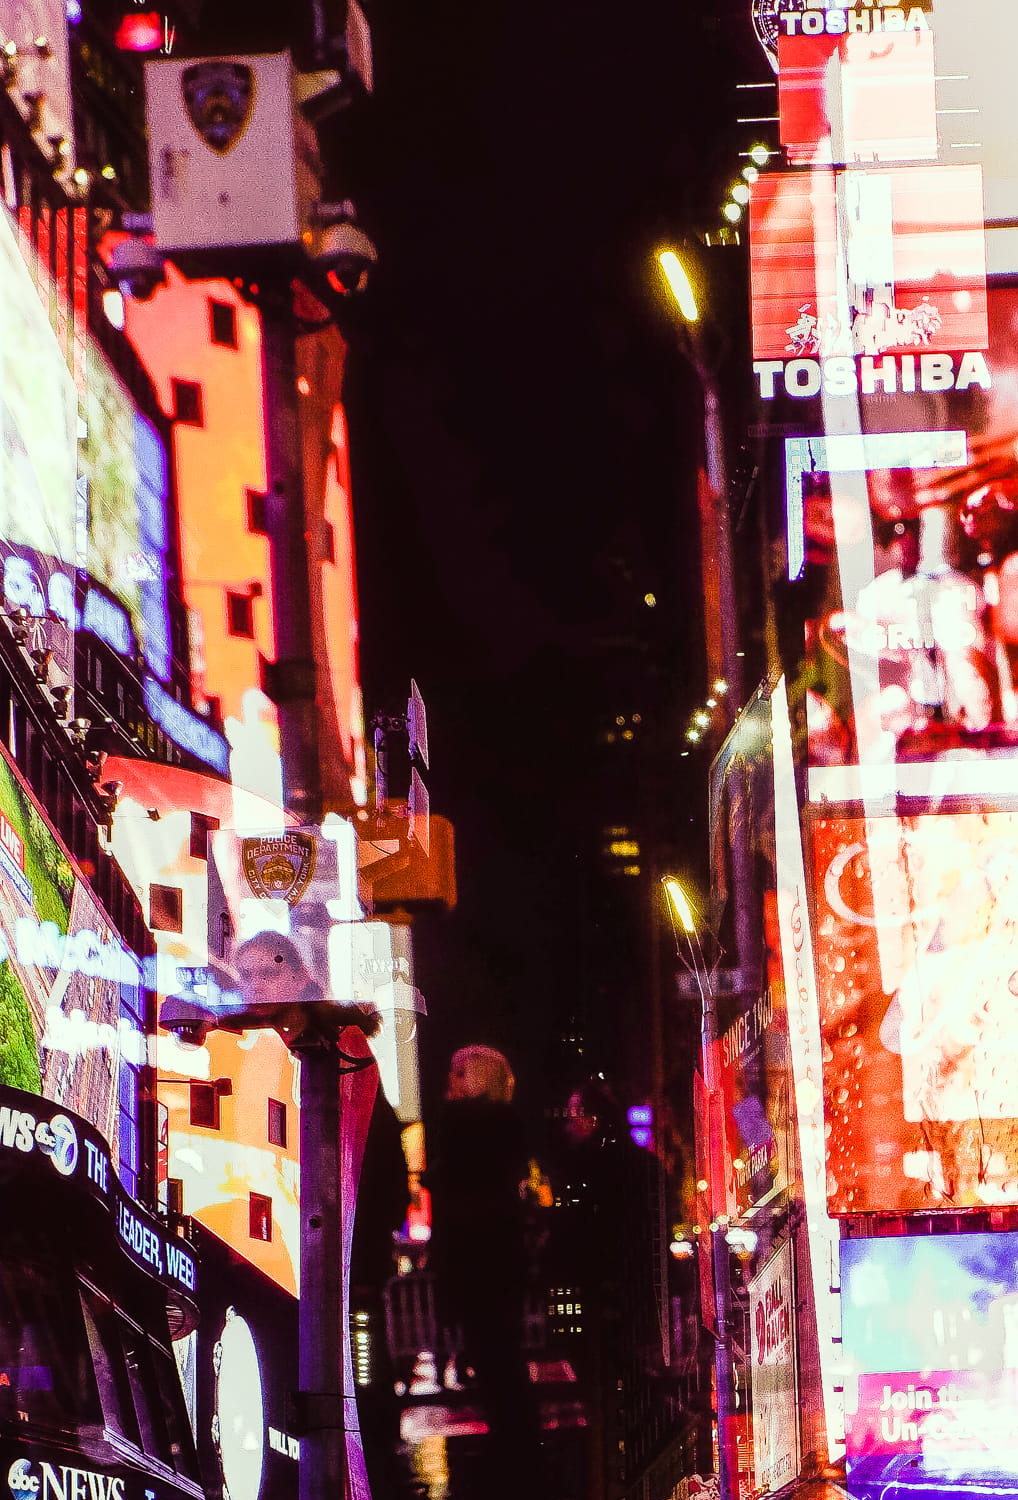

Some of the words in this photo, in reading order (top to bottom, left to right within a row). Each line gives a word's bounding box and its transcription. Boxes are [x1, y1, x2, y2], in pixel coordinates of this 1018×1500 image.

[779, 7, 929, 35] TOSHIBA
[752, 351, 993, 399] TOSHIBA
[247, 843, 310, 859] DEPARTMENT
[248, 869, 262, 890] CITY
[722, 1009, 751, 1068] SINCE
[119, 1200, 163, 1276] LEADER,
[880, 1384, 933, 1412] Join
